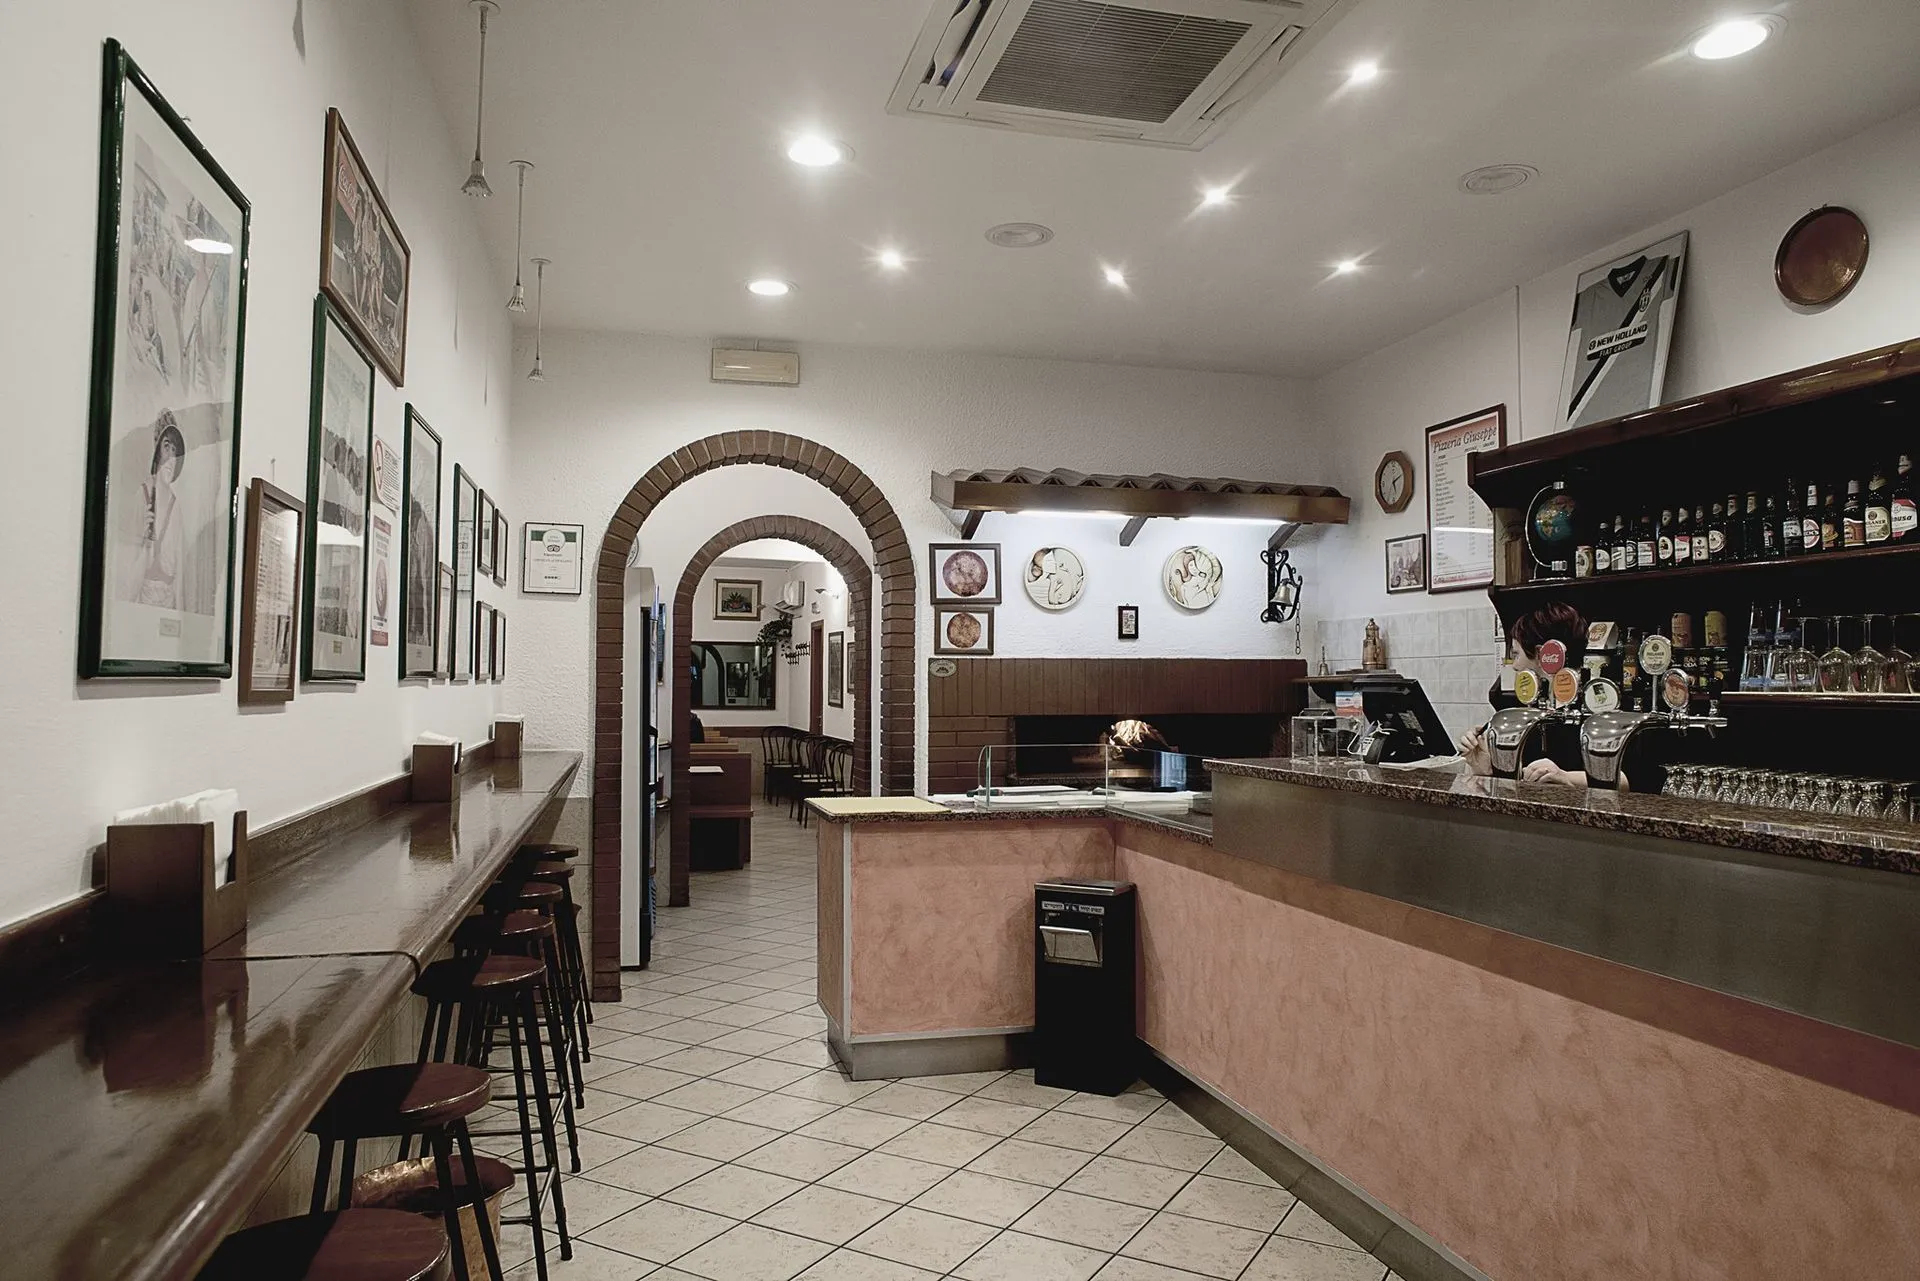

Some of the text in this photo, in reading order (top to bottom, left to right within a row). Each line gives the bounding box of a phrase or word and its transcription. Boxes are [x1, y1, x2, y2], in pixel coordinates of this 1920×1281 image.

[1615, 324, 1648, 341] HOLLAND
[1432, 435, 1461, 453] Pizzeria
[1463, 426, 1497, 444] Giuseppe
